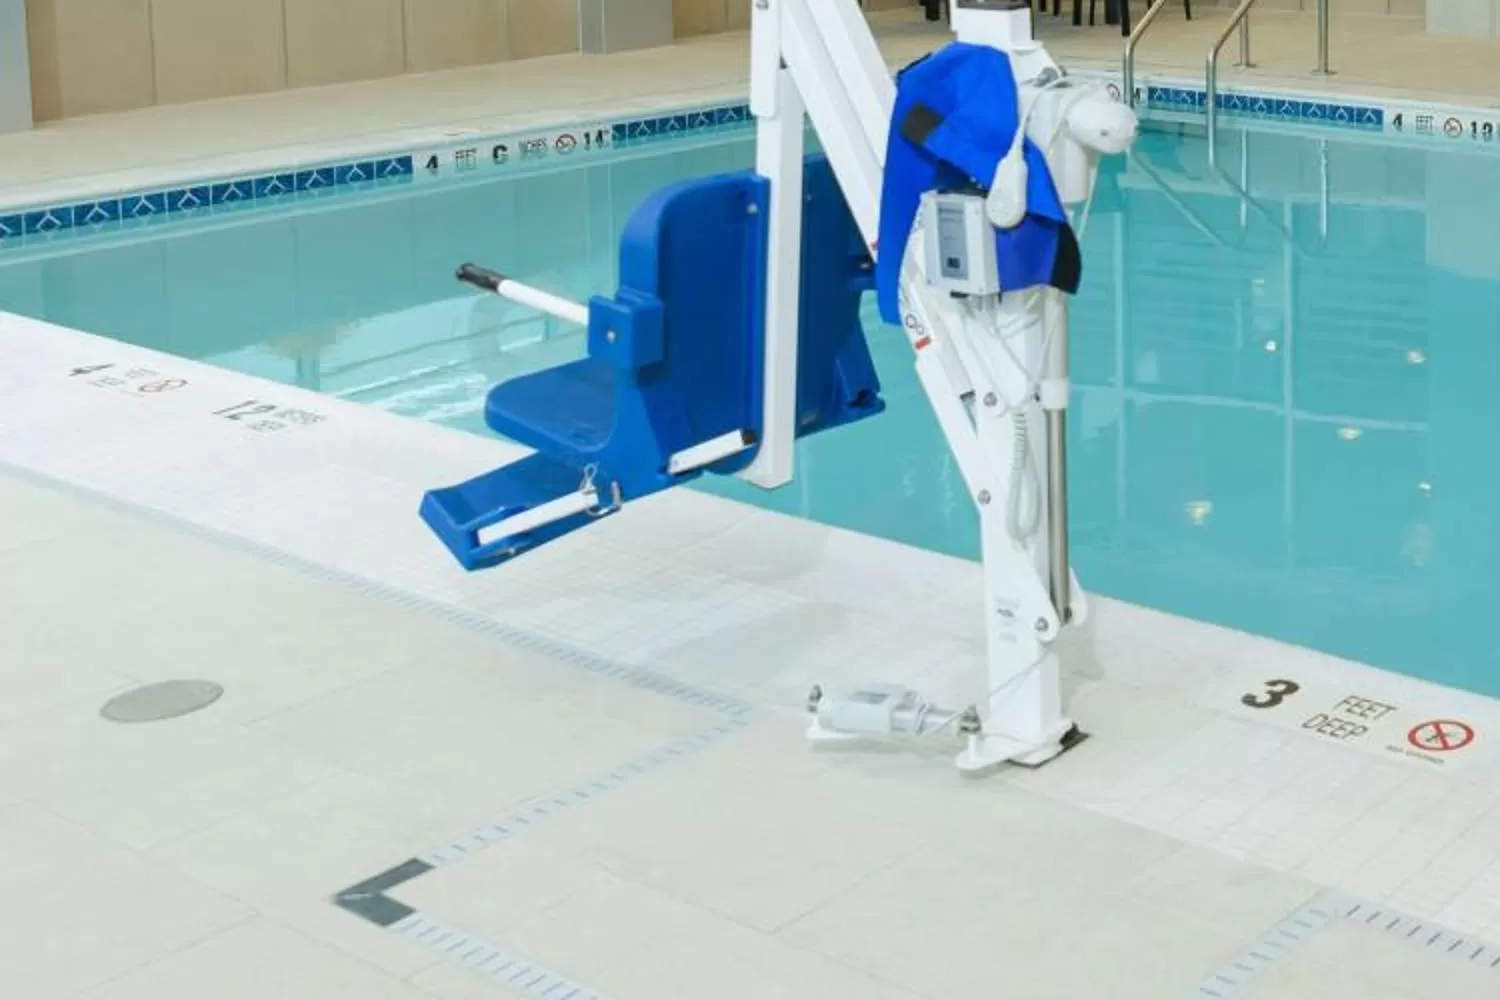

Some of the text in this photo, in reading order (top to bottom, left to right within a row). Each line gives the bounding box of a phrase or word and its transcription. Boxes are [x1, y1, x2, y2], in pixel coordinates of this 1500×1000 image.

[1241, 679, 1398, 720] 3 FEET
[1301, 713, 1369, 740] DEEP
